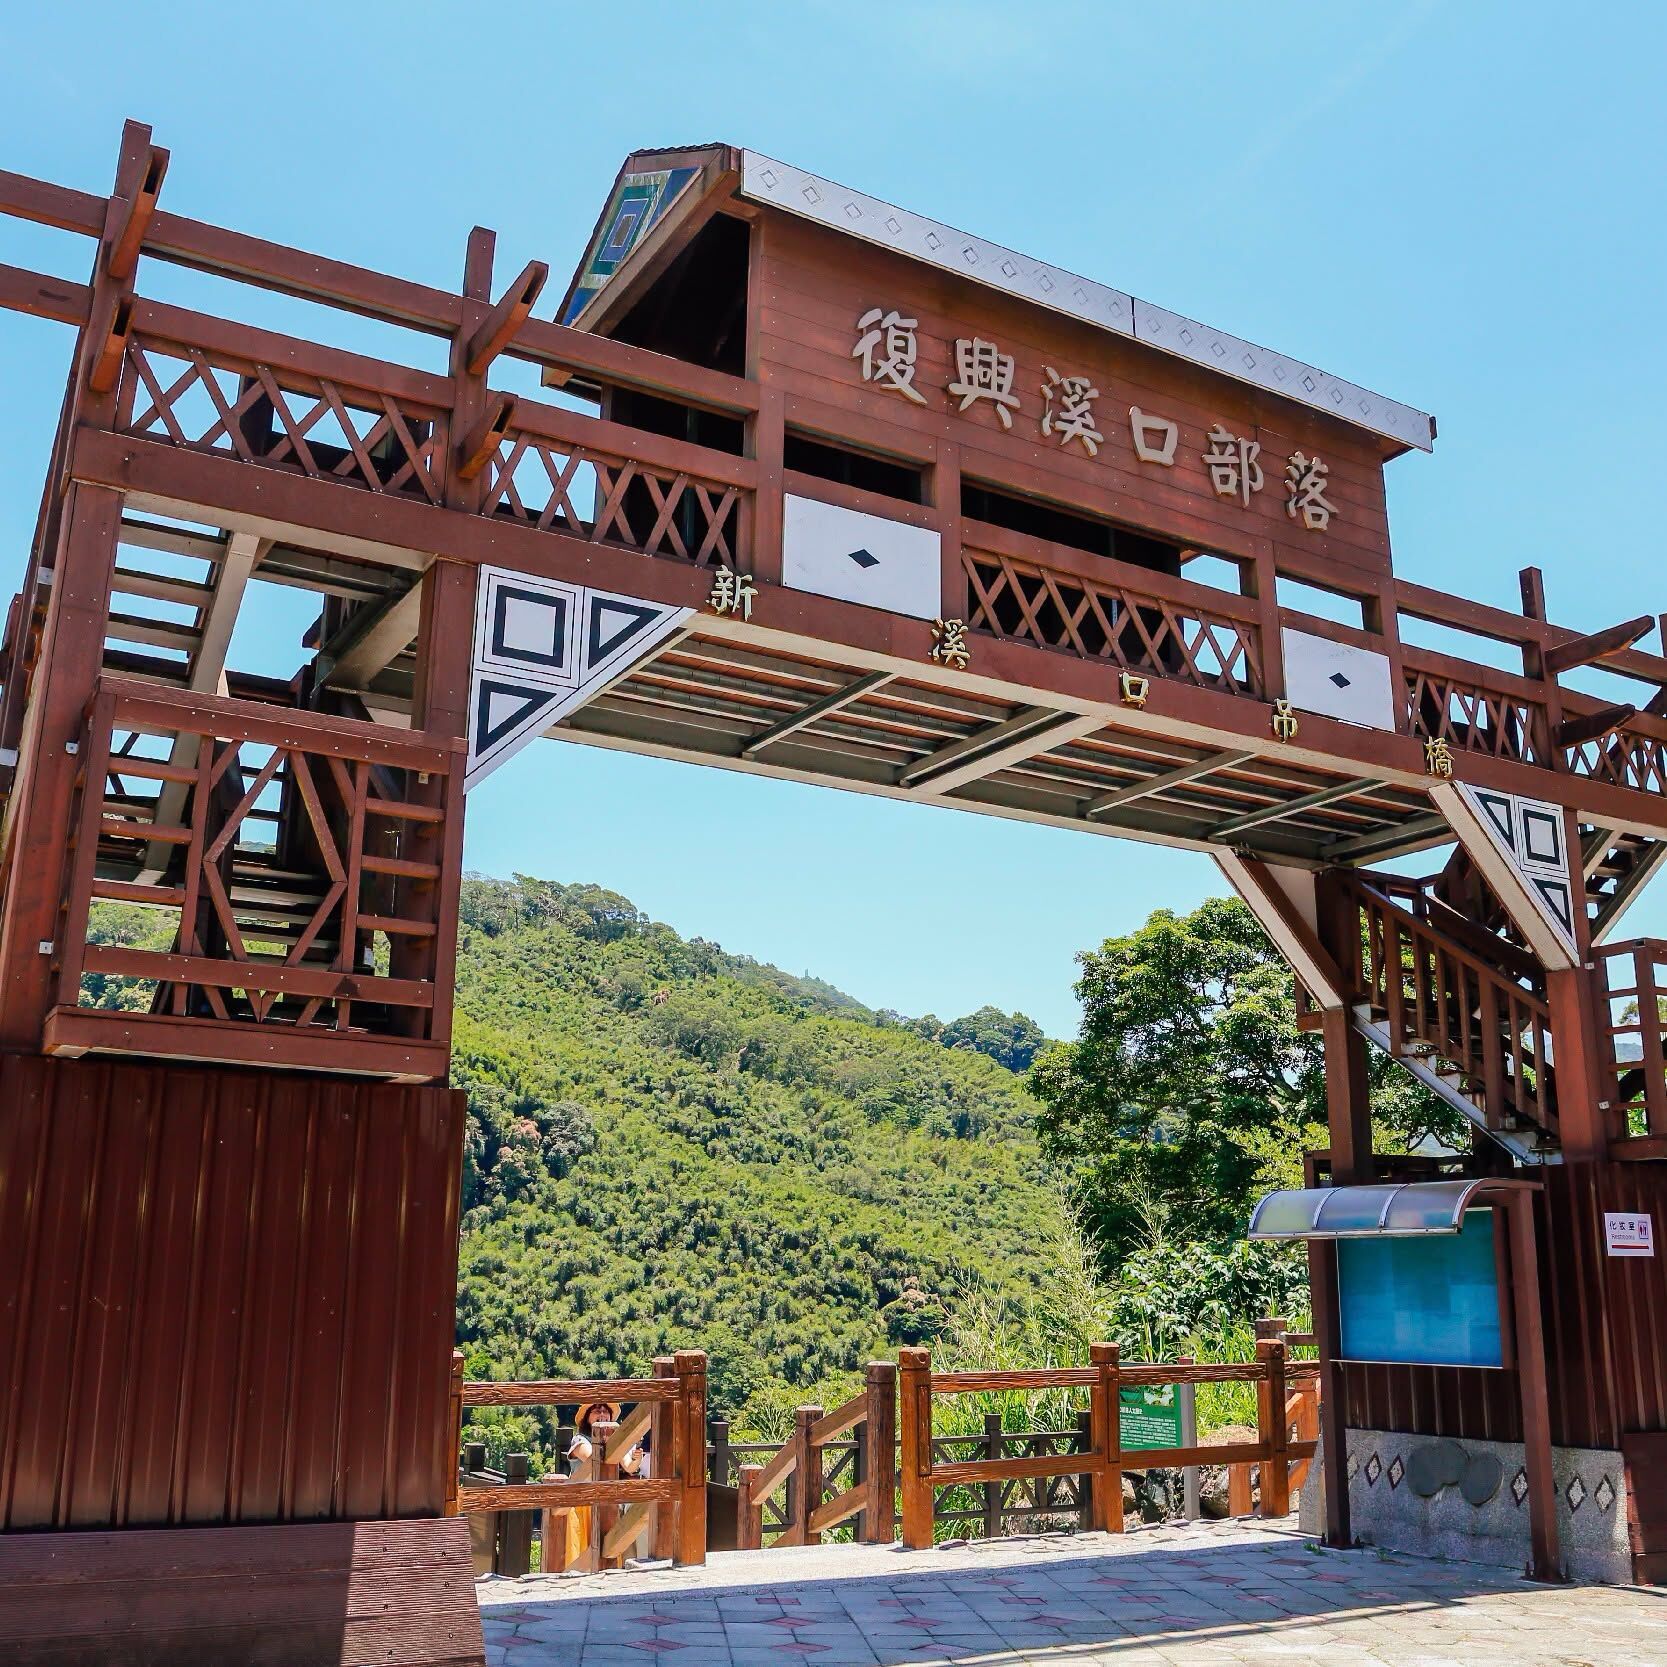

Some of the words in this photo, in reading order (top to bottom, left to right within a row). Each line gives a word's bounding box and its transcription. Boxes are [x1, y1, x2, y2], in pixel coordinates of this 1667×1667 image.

[852, 308, 1339, 532] 復興溪口部落
[705, 564, 1454, 778] 新溪口吊橋
